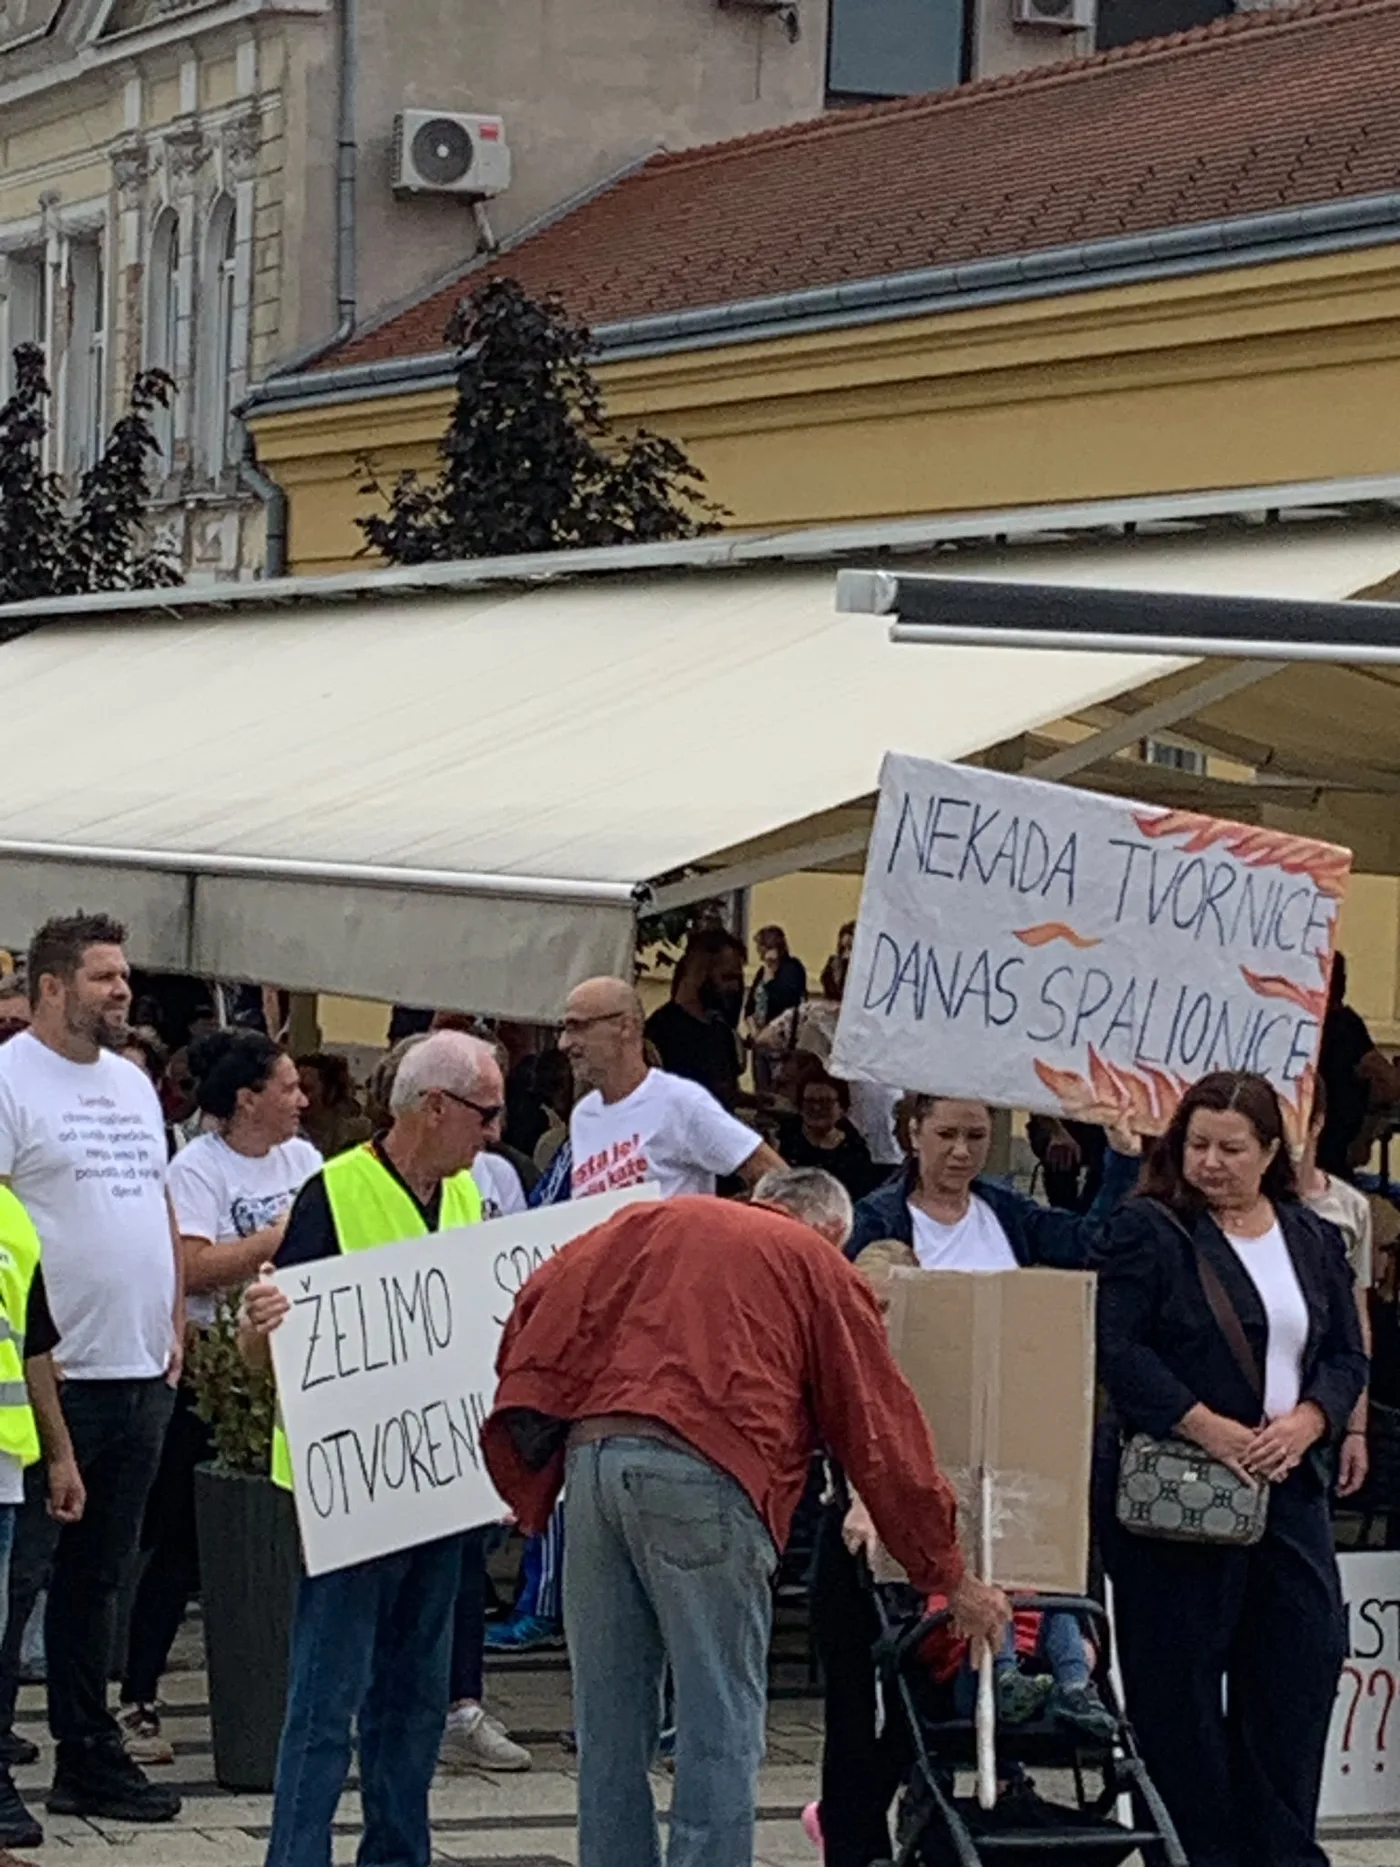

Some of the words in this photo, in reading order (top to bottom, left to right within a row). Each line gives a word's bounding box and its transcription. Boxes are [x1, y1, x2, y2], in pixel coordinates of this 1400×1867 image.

[887, 792, 1077, 905] NEKADA
[1109, 838, 1338, 958] TVORNICE
[863, 932, 1025, 1028] DANAS
[1027, 965, 1319, 1081] SPALIONICE
[293, 1266, 452, 1391] ŽELIMO
